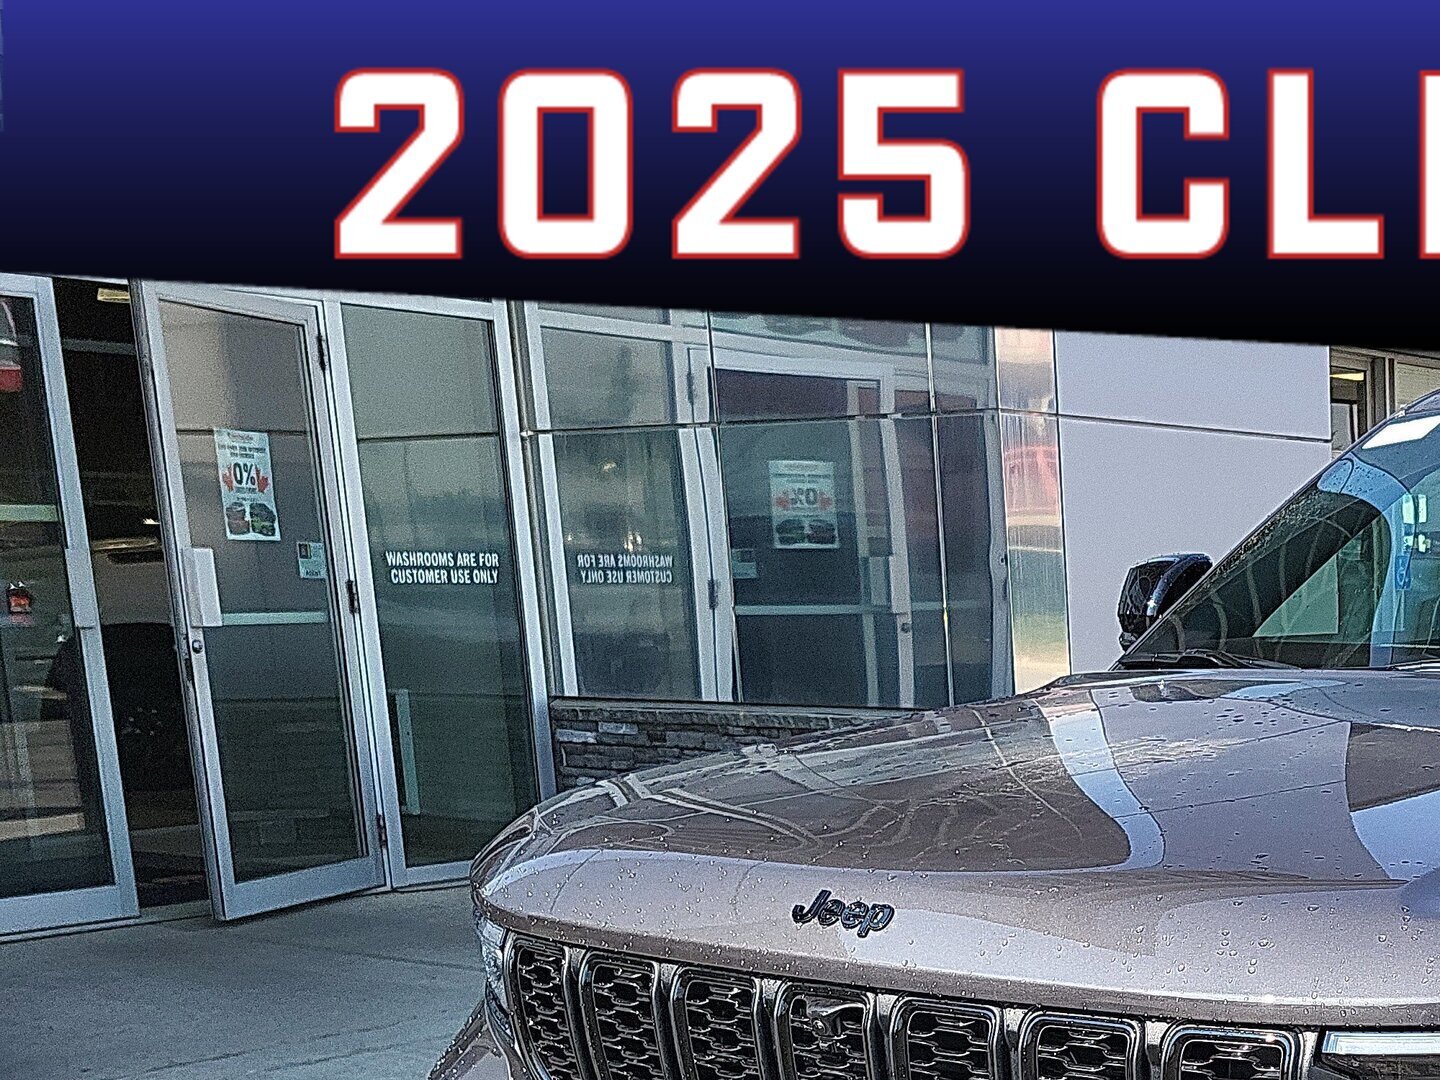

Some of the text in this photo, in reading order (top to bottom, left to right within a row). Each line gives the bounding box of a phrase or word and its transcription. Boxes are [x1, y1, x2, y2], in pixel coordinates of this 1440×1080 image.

[233, 462, 256, 486] 0%
[386, 551, 500, 567] WASHROOMS ARE FOR
[391, 568, 498, 583] CUSTOMER USE ONLY
[792, 889, 895, 938] Jeep
